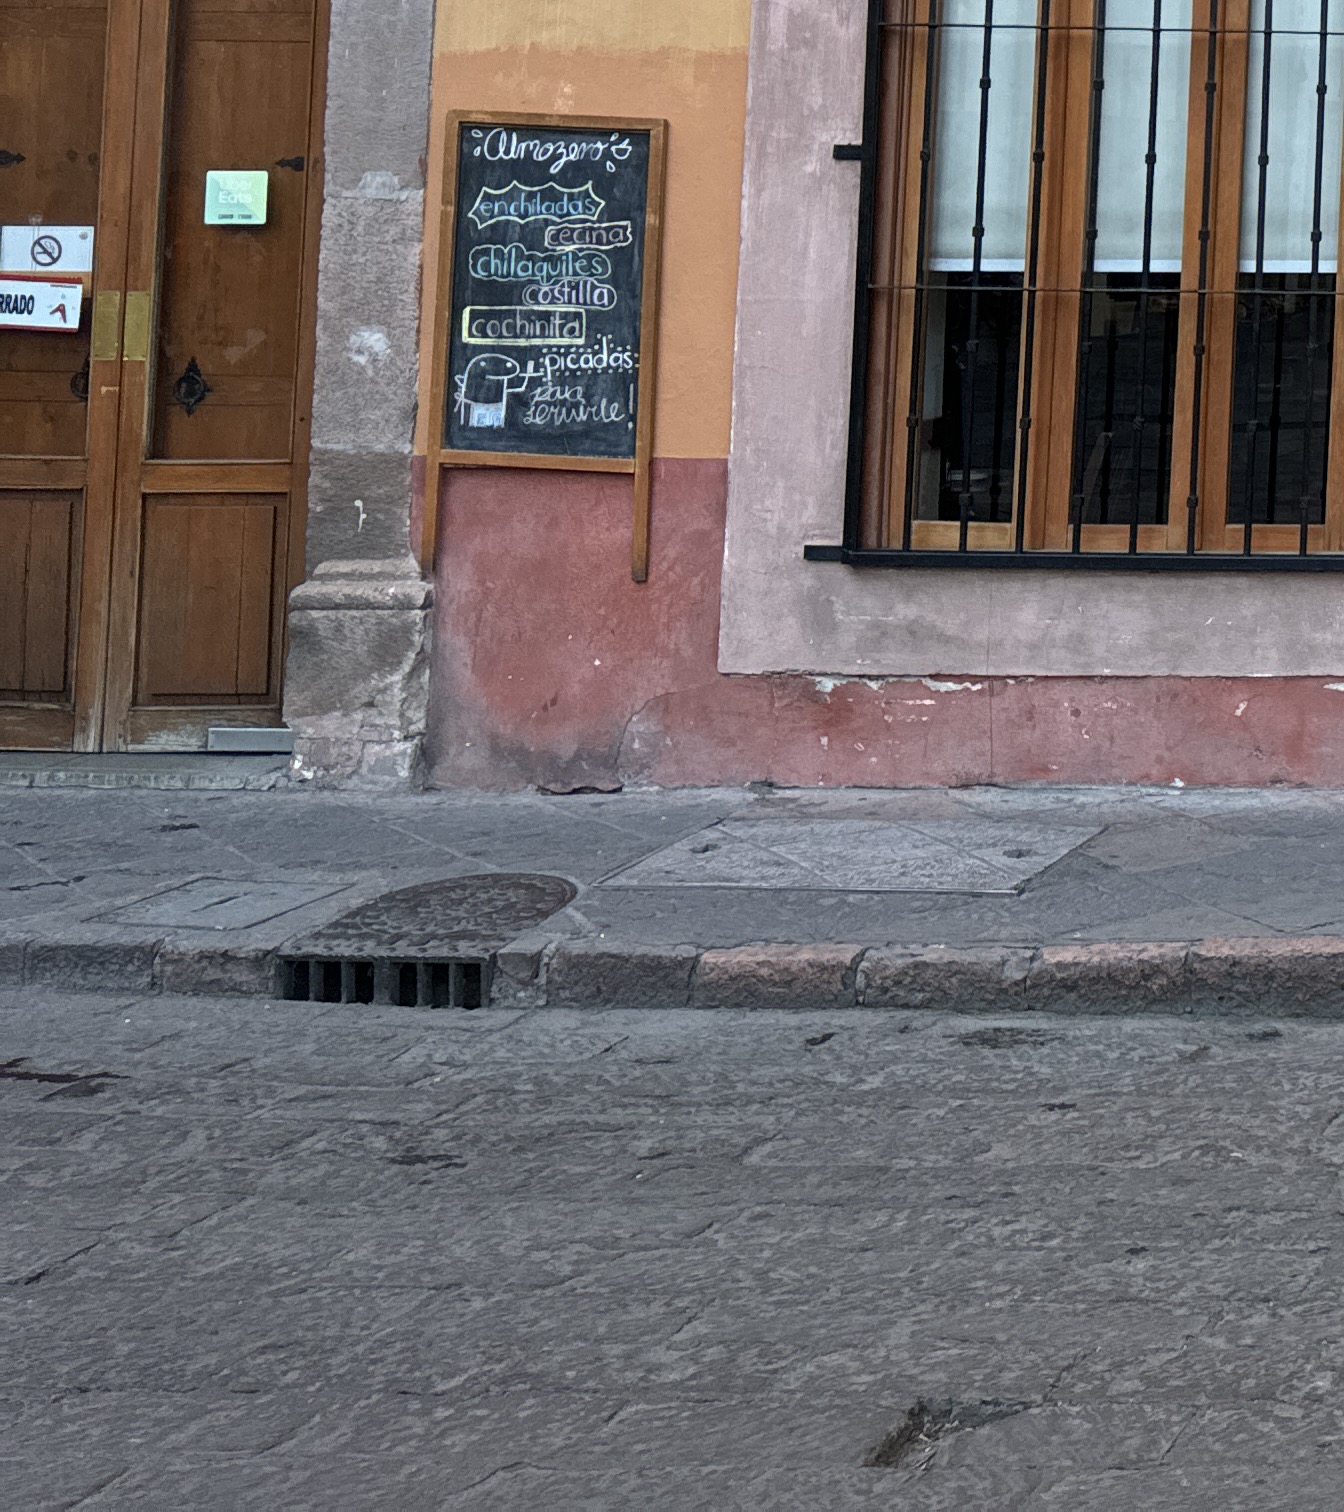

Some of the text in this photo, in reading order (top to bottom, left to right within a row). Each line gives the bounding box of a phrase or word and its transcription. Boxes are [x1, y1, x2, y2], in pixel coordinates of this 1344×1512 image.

[479, 192, 597, 217] enchiladas
[548, 225, 624, 246] cecina
[477, 247, 603, 284] chilaquiles
[525, 279, 609, 306] costilla
[471, 309, 580, 338] cochinita
[544, 336, 633, 381] picadas
[529, 386, 586, 406] para
